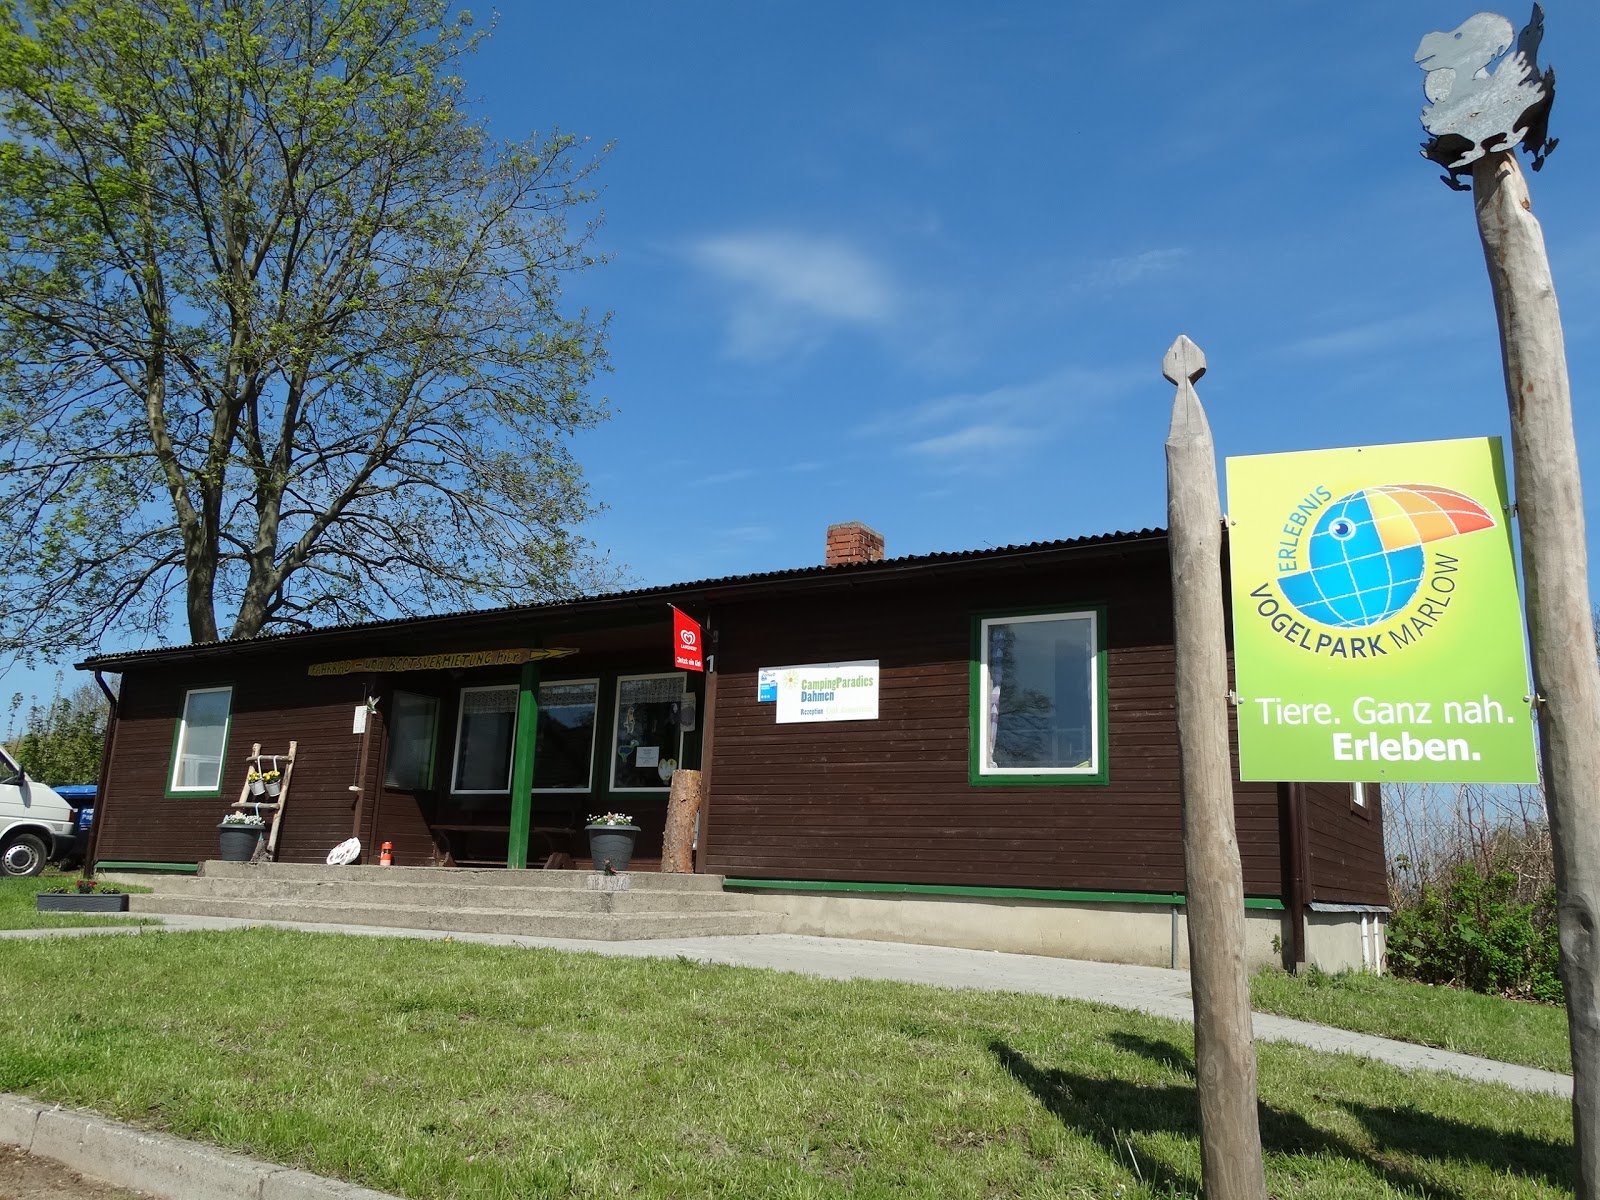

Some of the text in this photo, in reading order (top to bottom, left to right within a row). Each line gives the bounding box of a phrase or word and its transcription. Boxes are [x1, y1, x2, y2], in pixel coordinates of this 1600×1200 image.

[1278, 485, 1332, 572] ERLEBNIS
[1249, 553, 1459, 659] VOGELPARK MARLOW
[387, 650, 493, 672] BOOTSVERMIETUNG
[495, 649, 521, 664] hier
[706, 654, 714, 672] 1
[800, 690, 835, 703] Dahmen
[1254, 694, 1515, 725] Tiere. Ganz nah.
[1332, 731, 1482, 762] Erleben.
